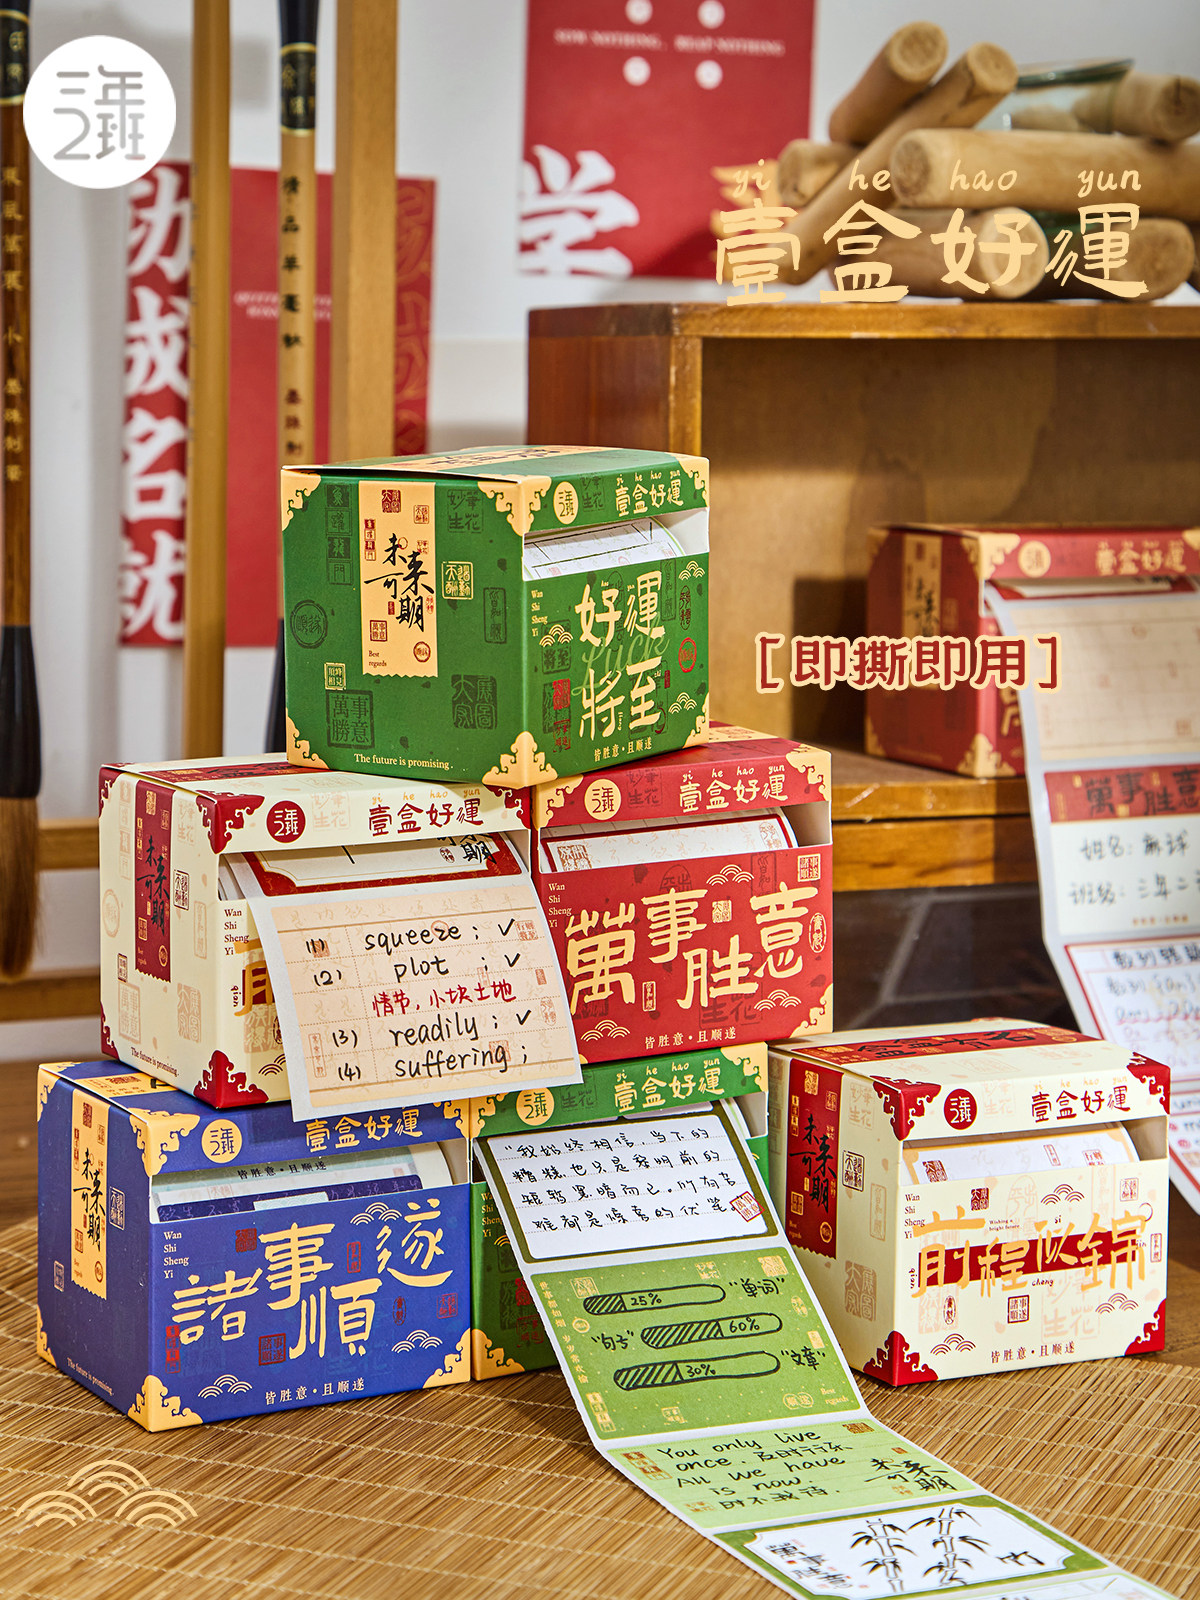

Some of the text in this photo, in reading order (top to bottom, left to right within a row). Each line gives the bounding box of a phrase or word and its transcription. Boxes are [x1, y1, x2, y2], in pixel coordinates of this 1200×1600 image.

[615, 479, 684, 517] 壹盒好運
[531, 589, 543, 598] Wan
[531, 604, 540, 612] Shi
[574, 570, 665, 647] 好運
[531, 615, 548, 624] Sheng
[532, 628, 539, 636] Yi
[354, 753, 454, 770] The future is promising.
[683, 764, 785, 781] yi he hao yun
[372, 788, 481, 805] yi he hao yun
[679, 774, 788, 813] 壹盒好運
[369, 798, 484, 837] 壹盒好運
[549, 895, 561, 903] Shi
[224, 909, 242, 917] Wan
[549, 907, 572, 916] Sheng
[224, 922, 237, 930] Shi
[224, 934, 250, 944] Sheng
[224, 947, 234, 956] Yi
[393, 955, 449, 983] plot
[617, 1058, 720, 1082] yi he hao yun
[614, 1067, 725, 1113] 壹盒好運
[1031, 1085, 1131, 1123] 壹盒好運
[306, 1109, 423, 1153] 壹盒好運
[481, 1192, 494, 1201] Wa
[905, 1193, 920, 1201] Wan
[481, 1205, 494, 1214] Shi
[904, 1206, 915, 1214] Shi
[904, 1217, 925, 1227] Sheng
[164, 1231, 182, 1239] Wan
[483, 1229, 492, 1237] Yi
[904, 1230, 913, 1239] Yi
[164, 1244, 177, 1252] Shi
[164, 1256, 189, 1266] Sheng
[164, 1270, 173, 1279] Yi
[631, 1292, 662, 1306] 25%
[729, 1316, 760, 1333] 60%
[686, 1364, 716, 1378] 30%
[657, 1430, 821, 1460] You only live
[728, 1467, 766, 1482] we
[784, 1456, 846, 1473] have
[711, 1486, 736, 1496] is
